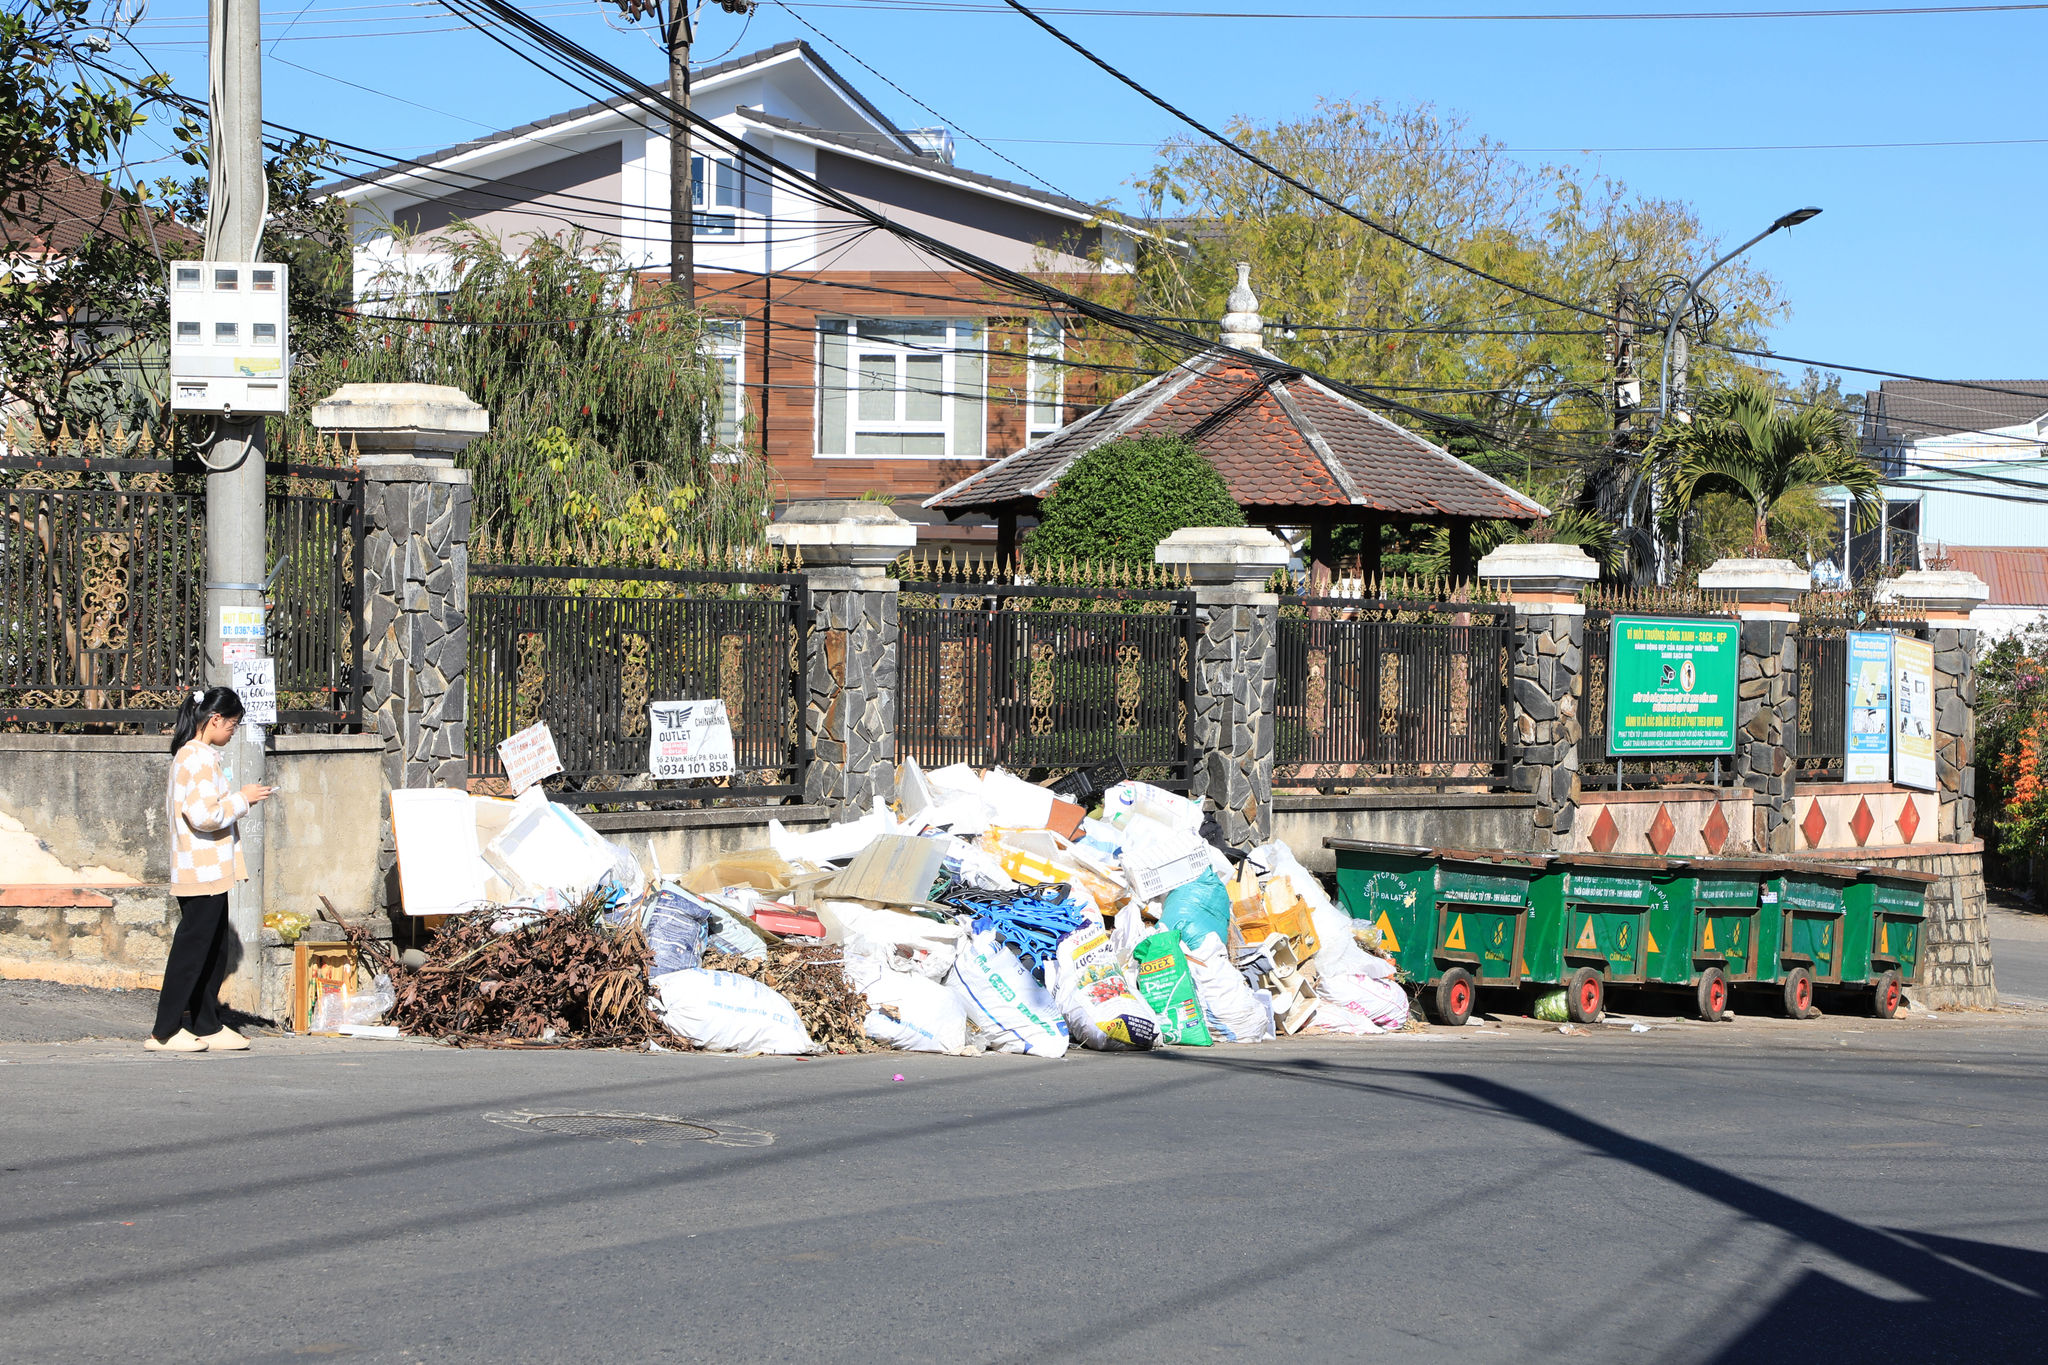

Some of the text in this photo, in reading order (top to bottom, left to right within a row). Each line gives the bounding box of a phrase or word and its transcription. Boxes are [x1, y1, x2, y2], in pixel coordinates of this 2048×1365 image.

[250, 688, 265, 698] 600
[660, 730, 691, 742] OUTLET
[659, 761, 728, 775] 0934 101 858
